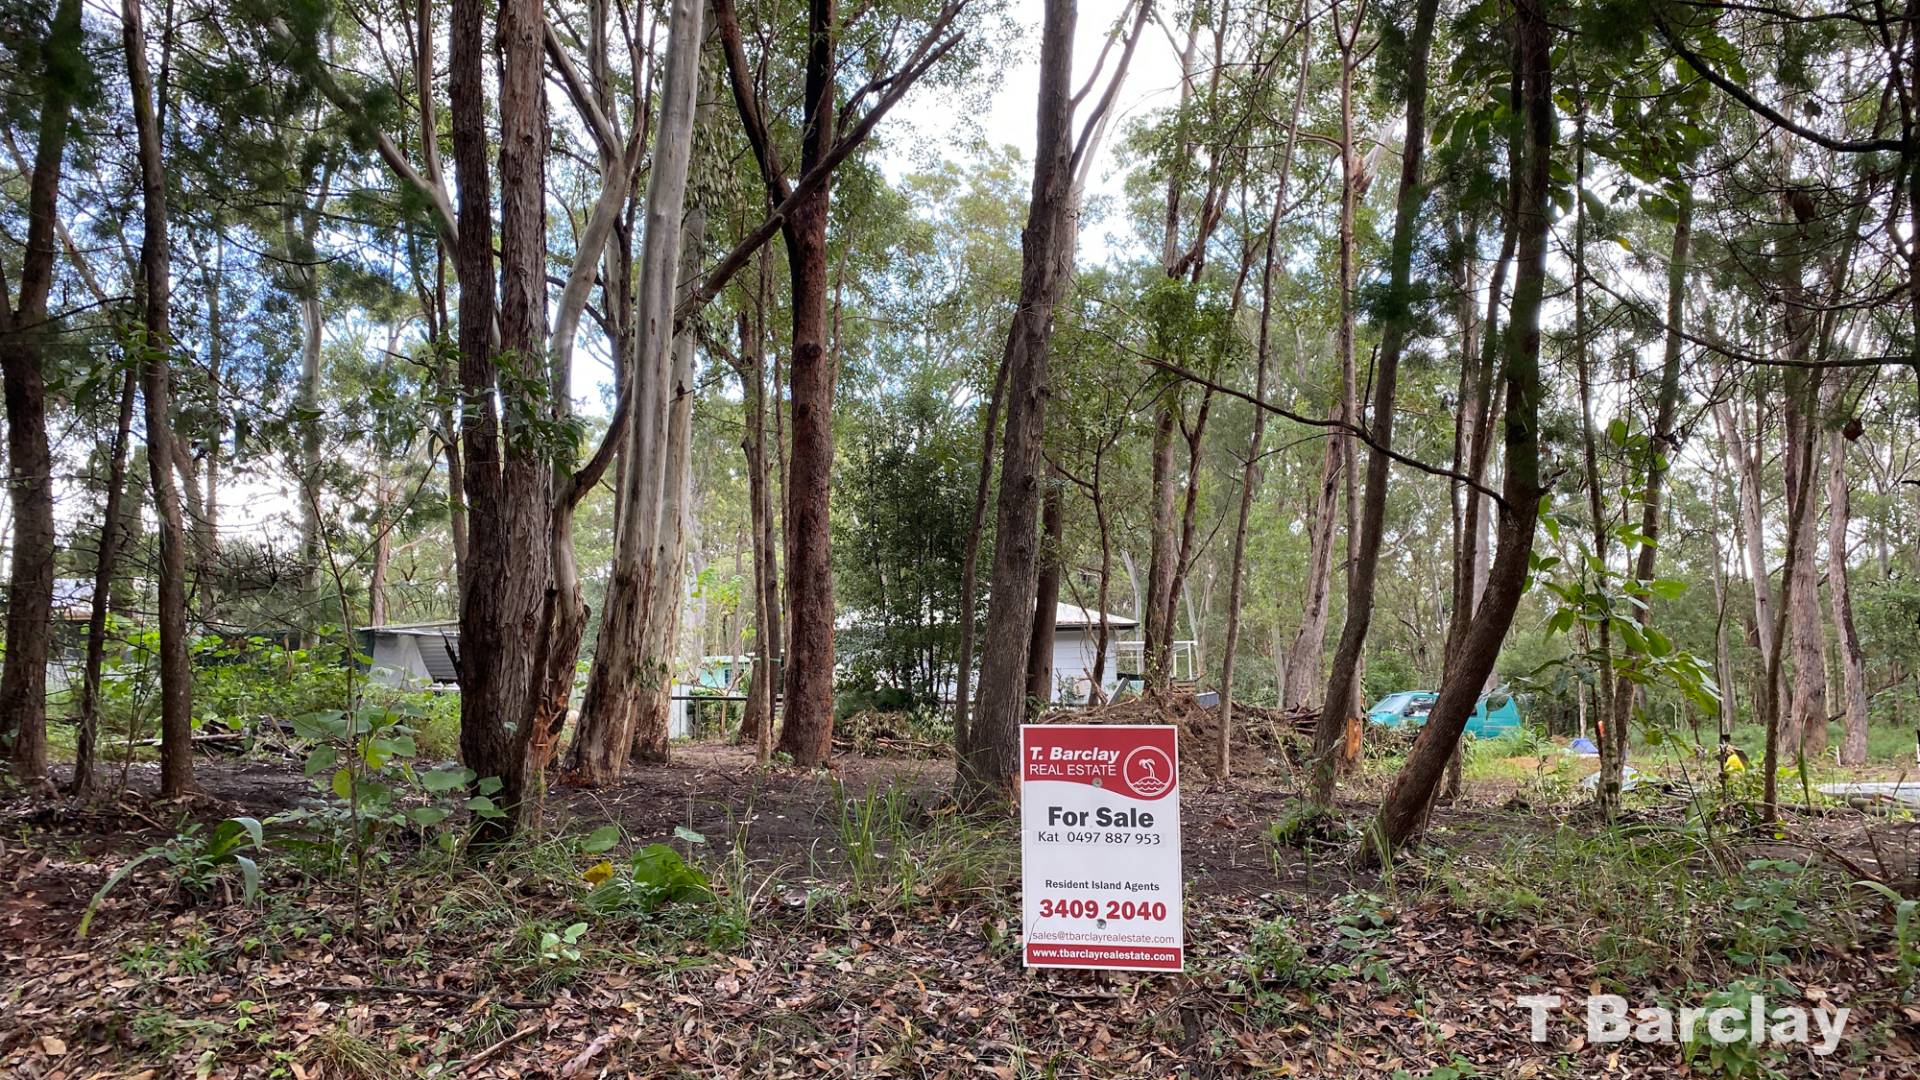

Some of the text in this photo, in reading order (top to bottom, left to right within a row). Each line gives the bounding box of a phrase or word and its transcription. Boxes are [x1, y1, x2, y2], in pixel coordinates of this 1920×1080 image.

[1030, 747, 1120, 764] T. Barclay
[1030, 764, 1116, 776] REAL ESTATE
[1048, 806, 1154, 828] For Sale
[1038, 831, 1160, 845] Kat 0497 887 953
[1045, 880, 1160, 892] Resident Island Agents
[1039, 899, 1167, 921] 3409 2040
[1032, 931, 1175, 944] sales@tbarclayrealestate.com
[1032, 948, 1176, 962] www.tbarclayrealestate.com
